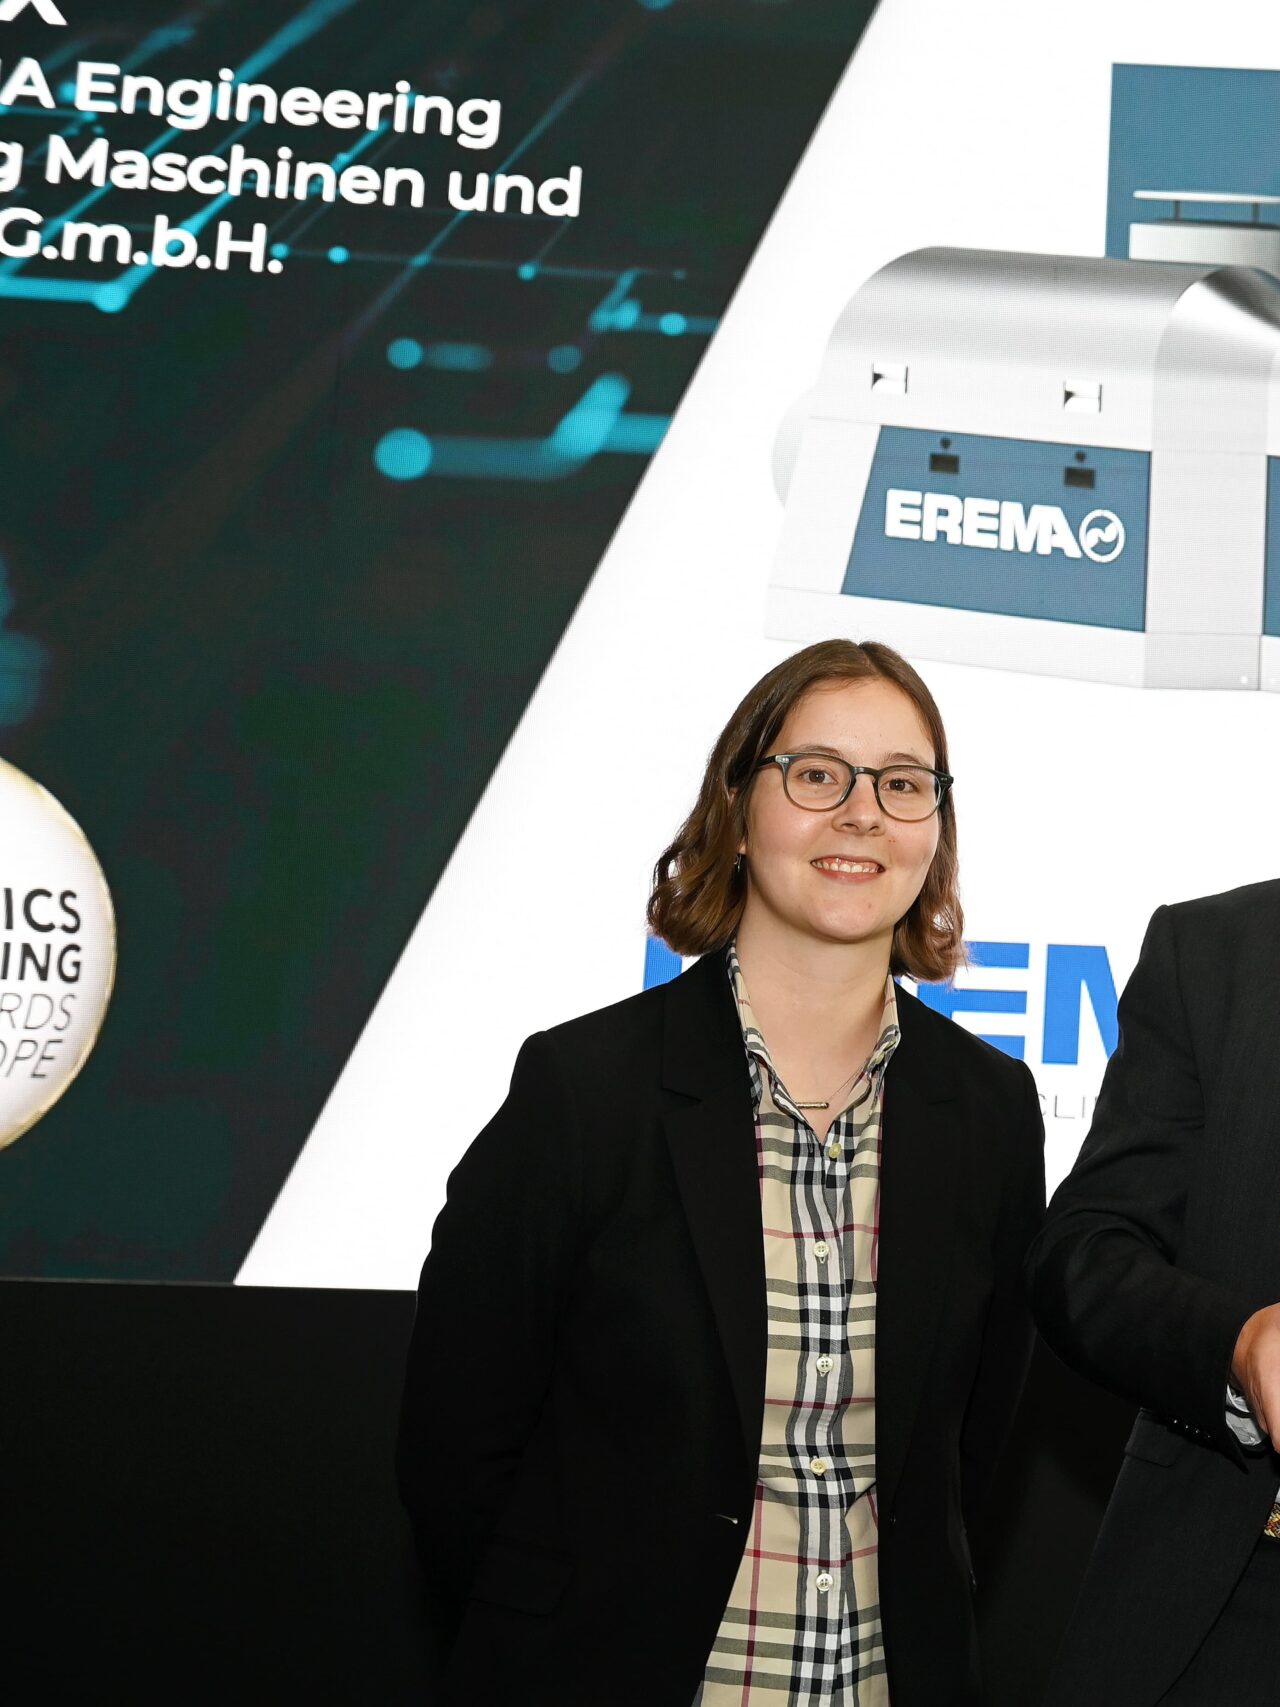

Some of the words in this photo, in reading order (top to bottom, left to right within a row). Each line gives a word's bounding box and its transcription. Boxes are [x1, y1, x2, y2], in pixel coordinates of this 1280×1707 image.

[0, 57, 56, 109] A
[75, 61, 501, 150] Engineering
[46, 134, 425, 208] Maschinen
[447, 166, 583, 218] und
[0, 206, 284, 274] G.m.b.H.
[884, 488, 1082, 558] EREMA
[3, 887, 81, 934] ICS
[0, 942, 81, 984] ING
